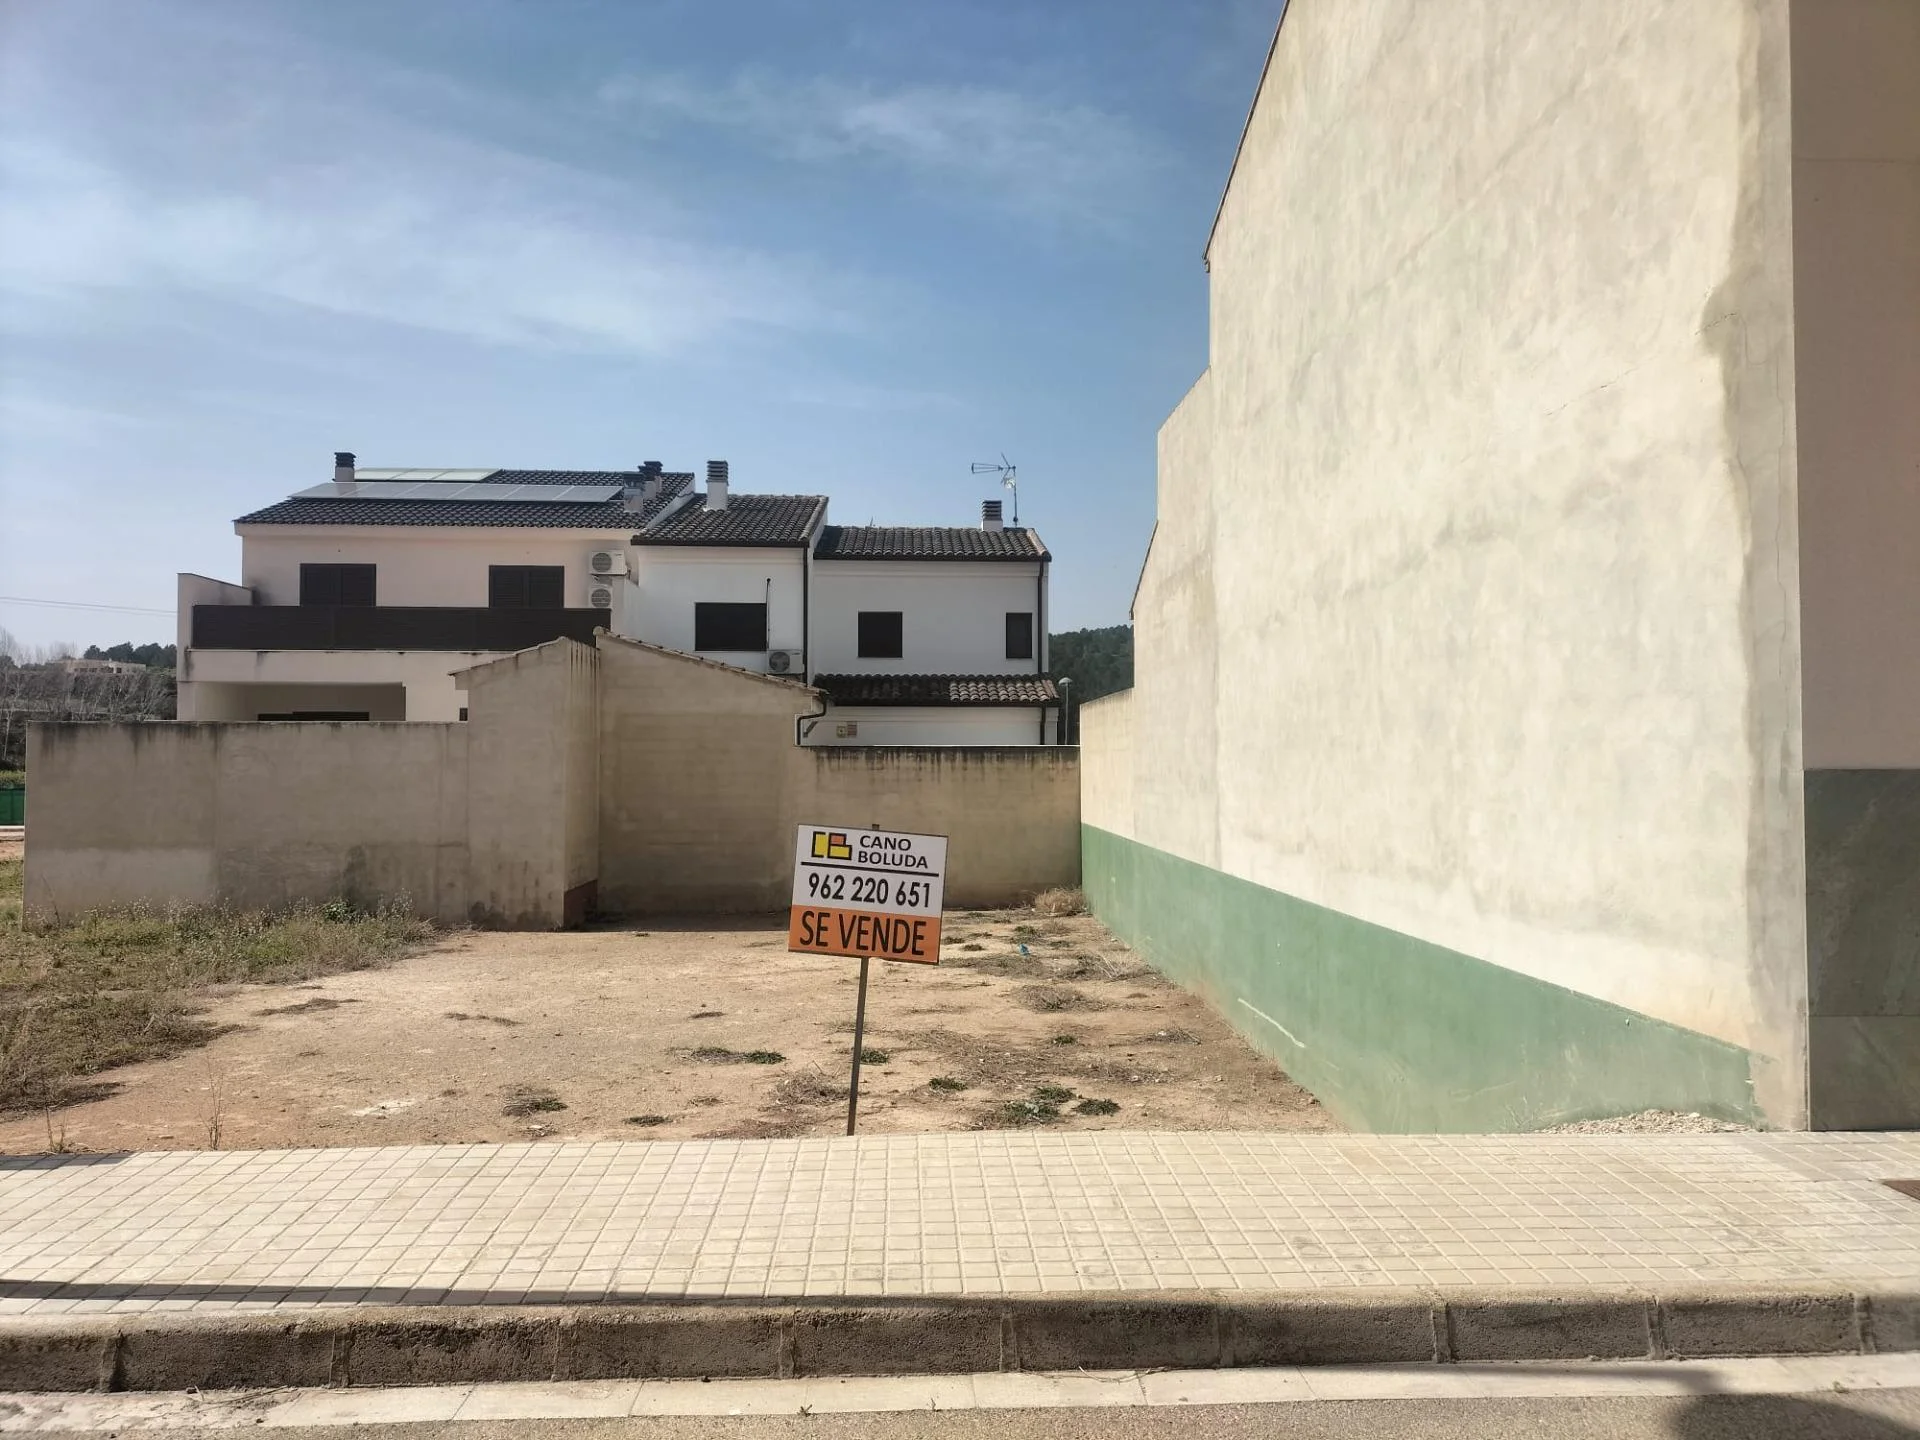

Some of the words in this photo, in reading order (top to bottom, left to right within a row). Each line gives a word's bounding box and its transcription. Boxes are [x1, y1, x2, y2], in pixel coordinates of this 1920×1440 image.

[859, 835, 912, 851] CANO
[857, 851, 928, 869] BOLUDA
[808, 873, 845, 900] 962
[850, 876, 889, 904] 220
[895, 881, 930, 908] 651
[800, 910, 831, 946] SE
[838, 913, 927, 956] VENDE
